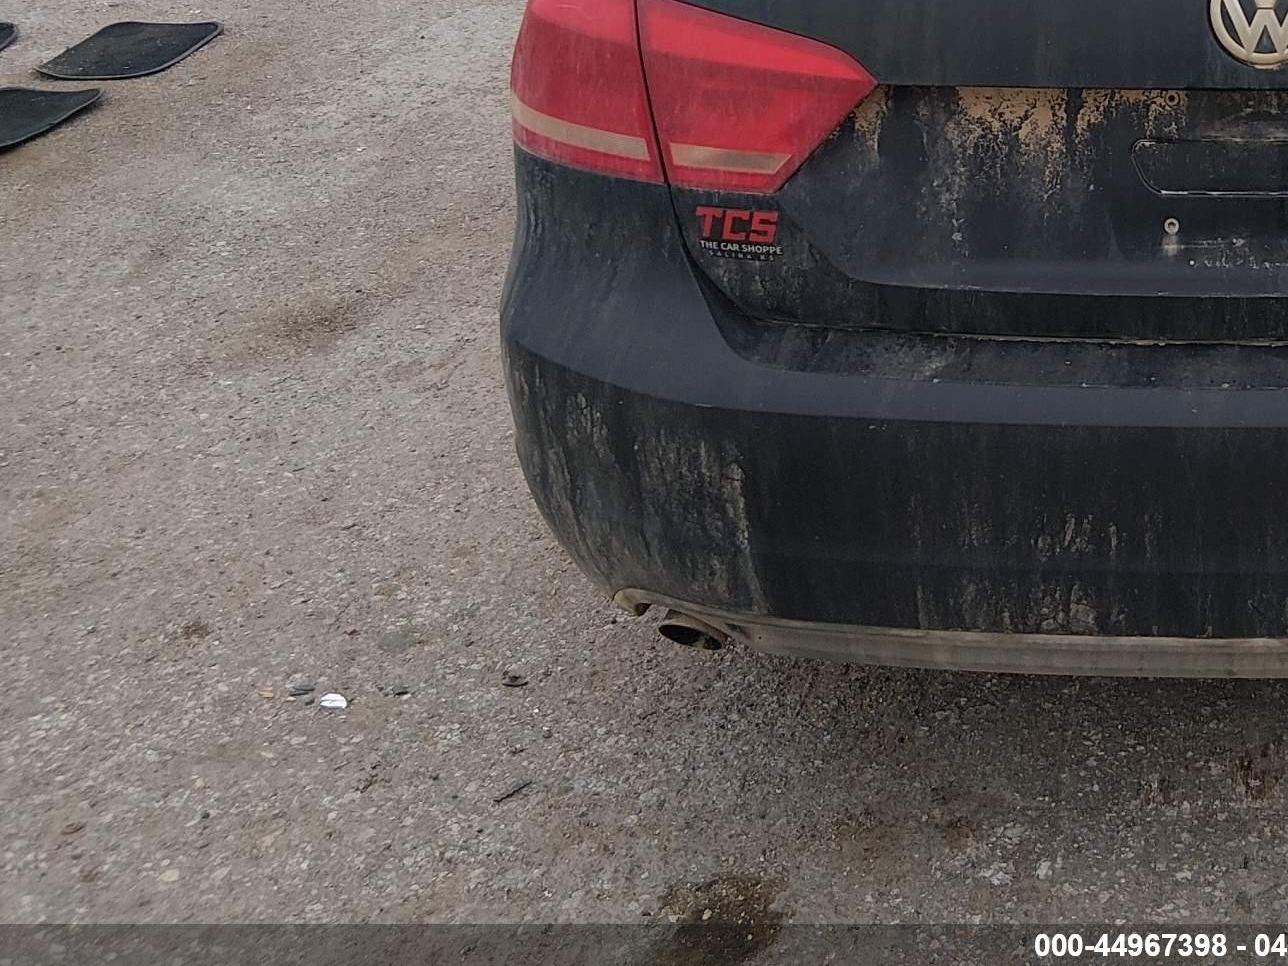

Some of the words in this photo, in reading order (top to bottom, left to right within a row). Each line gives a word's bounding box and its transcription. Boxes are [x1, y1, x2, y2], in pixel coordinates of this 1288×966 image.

[695, 206, 779, 244] TCS
[699, 240, 719, 250] THE
[720, 242, 740, 251] CAR
[741, 245, 783, 255] SHOPPE
